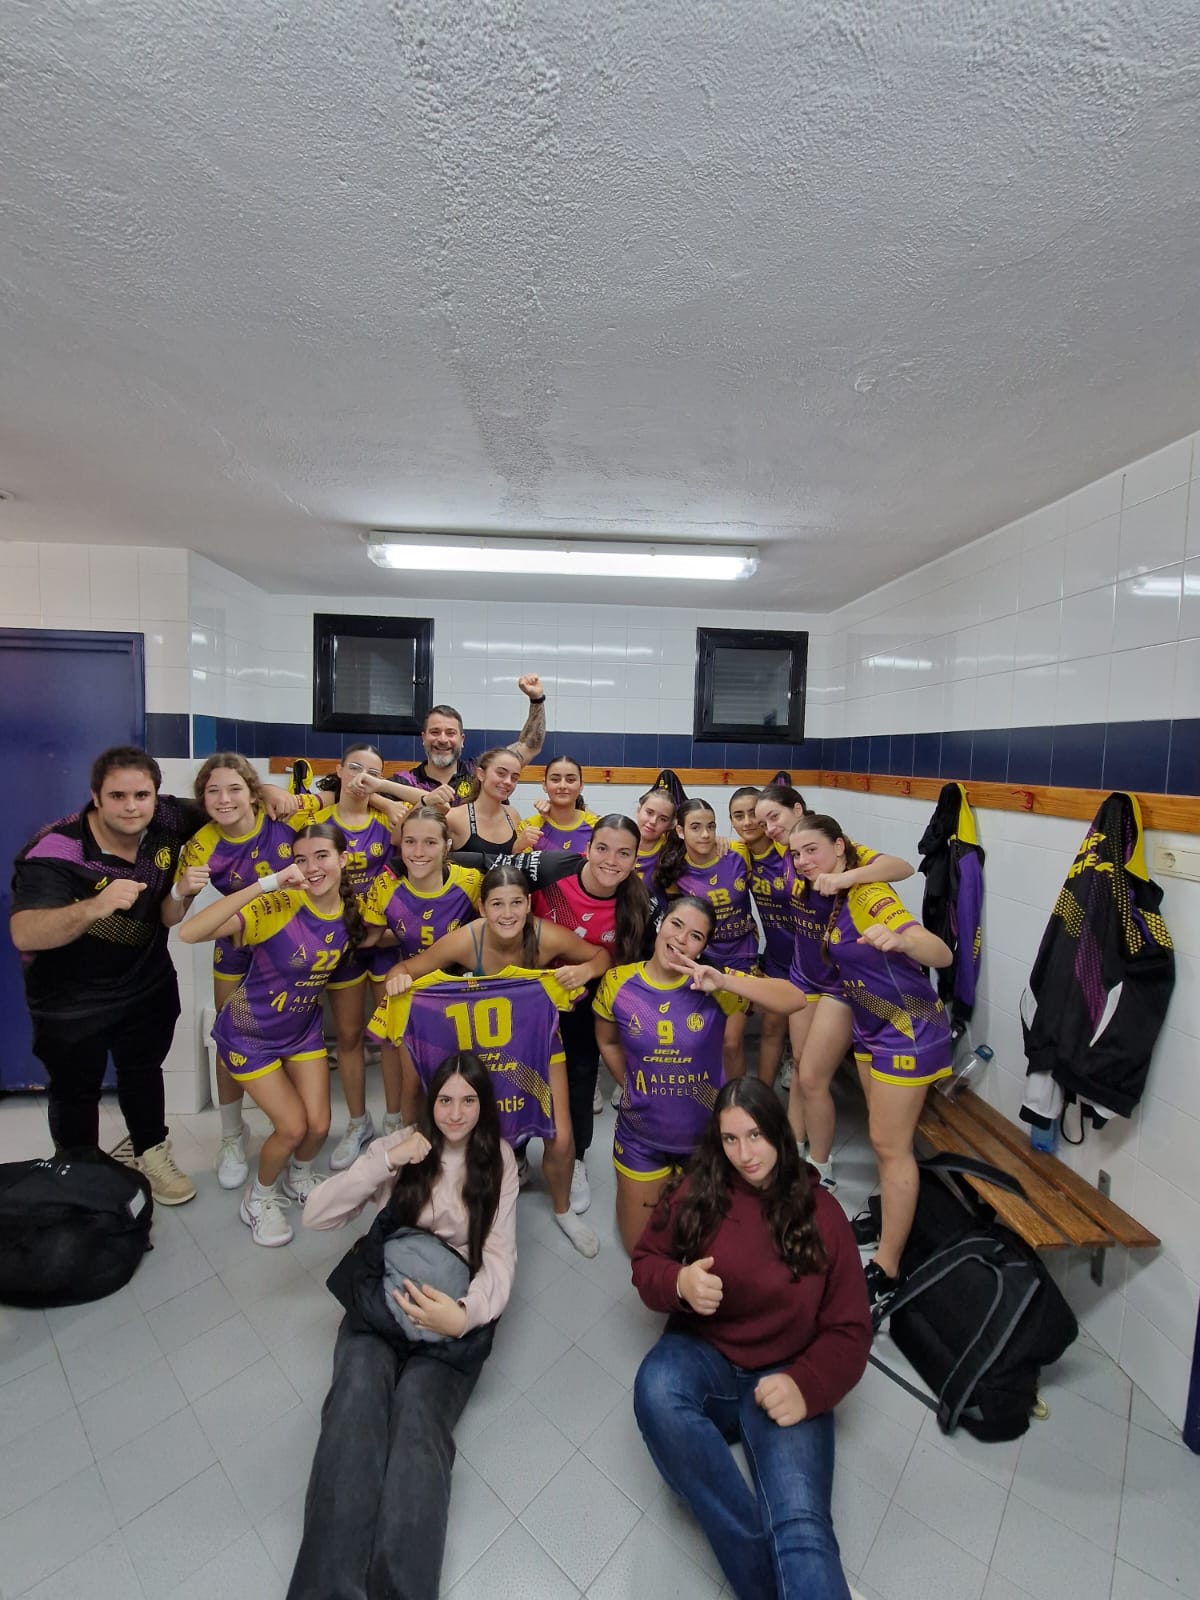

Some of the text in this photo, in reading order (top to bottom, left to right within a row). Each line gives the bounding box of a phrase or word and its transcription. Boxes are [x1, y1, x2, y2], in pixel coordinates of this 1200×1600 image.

[255, 861, 273, 878] 8
[707, 888, 731, 907] 13
[421, 926, 434, 946] 5
[311, 949, 341, 971] 22
[293, 994, 318, 1004] ALE
[289, 1005, 313, 1013] HOT
[446, 996, 512, 1050] 10
[657, 1020, 673, 1044] 9
[478, 1053, 500, 1061] EH
[651, 1071, 709, 1084] ALEGRIA
[652, 1086, 699, 1097] HOTELS
[497, 1096, 525, 1112] ntis
